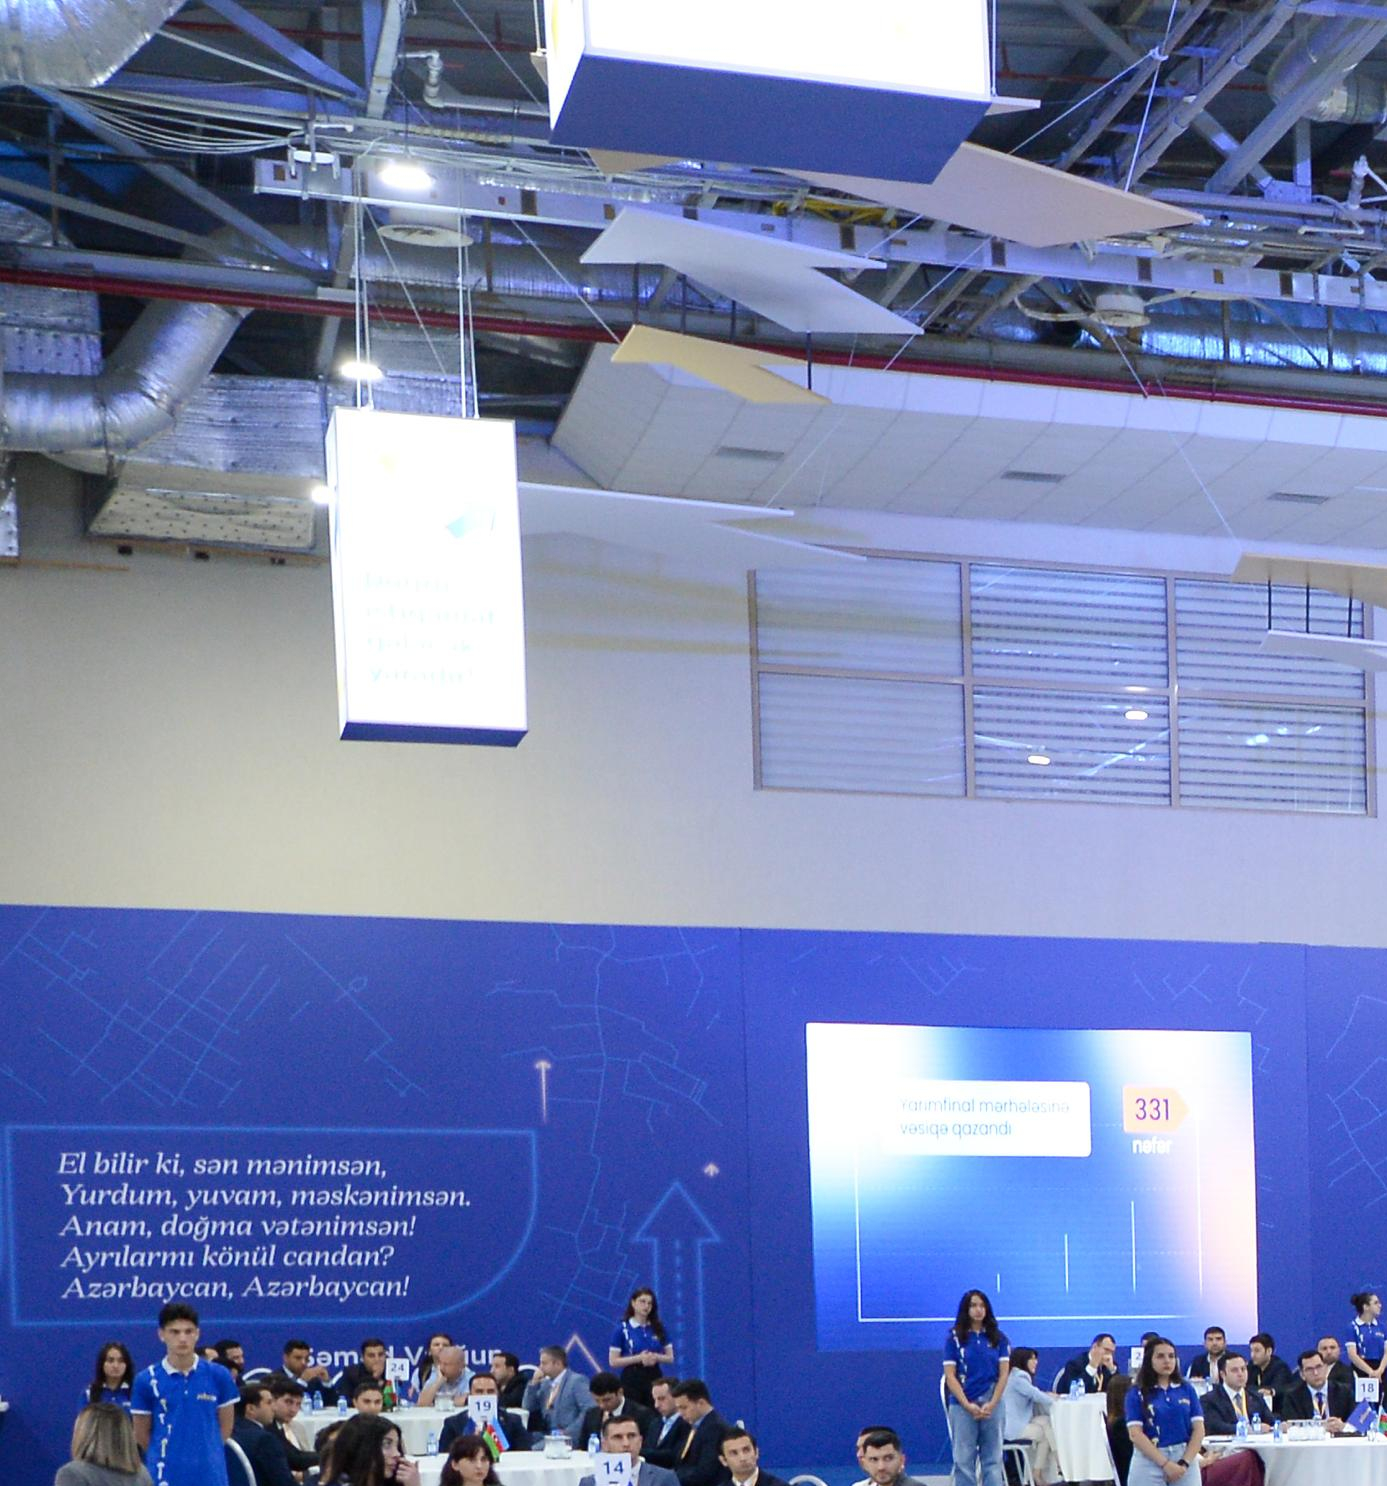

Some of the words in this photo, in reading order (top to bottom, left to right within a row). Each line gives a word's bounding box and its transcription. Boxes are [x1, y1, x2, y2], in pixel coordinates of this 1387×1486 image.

[1134, 1097, 1170, 1121] 331
[57, 1151, 86, 1174] El
[93, 1151, 149, 1175] bilir
[155, 1151, 185, 1178] ki,
[193, 1158, 238, 1175] sən
[246, 1153, 388, 1179] mənimsən,
[60, 1182, 178, 1208] Yurdum,
[184, 1188, 282, 1212] yuvam,
[290, 1183, 472, 1207] məskənimsən.
[58, 1214, 152, 1239] Anam,
[160, 1213, 252, 1242] doğma
[261, 1214, 417, 1236] vətənimsən!
[59, 1244, 194, 1274] Ayrılarmı
[202, 1243, 276, 1267] könül
[282, 1243, 396, 1267] candan?
[60, 1275, 234, 1304] Azərbaycan,
[240, 1274, 411, 1303] Azərbaycan!
[307, 1345, 395, 1367] Səmd
[390, 1362, 406, 1373] 24
[1360, 1383, 1375, 1393] 18
[475, 1400, 492, 1412] 19
[603, 1461, 624, 1475] 14
